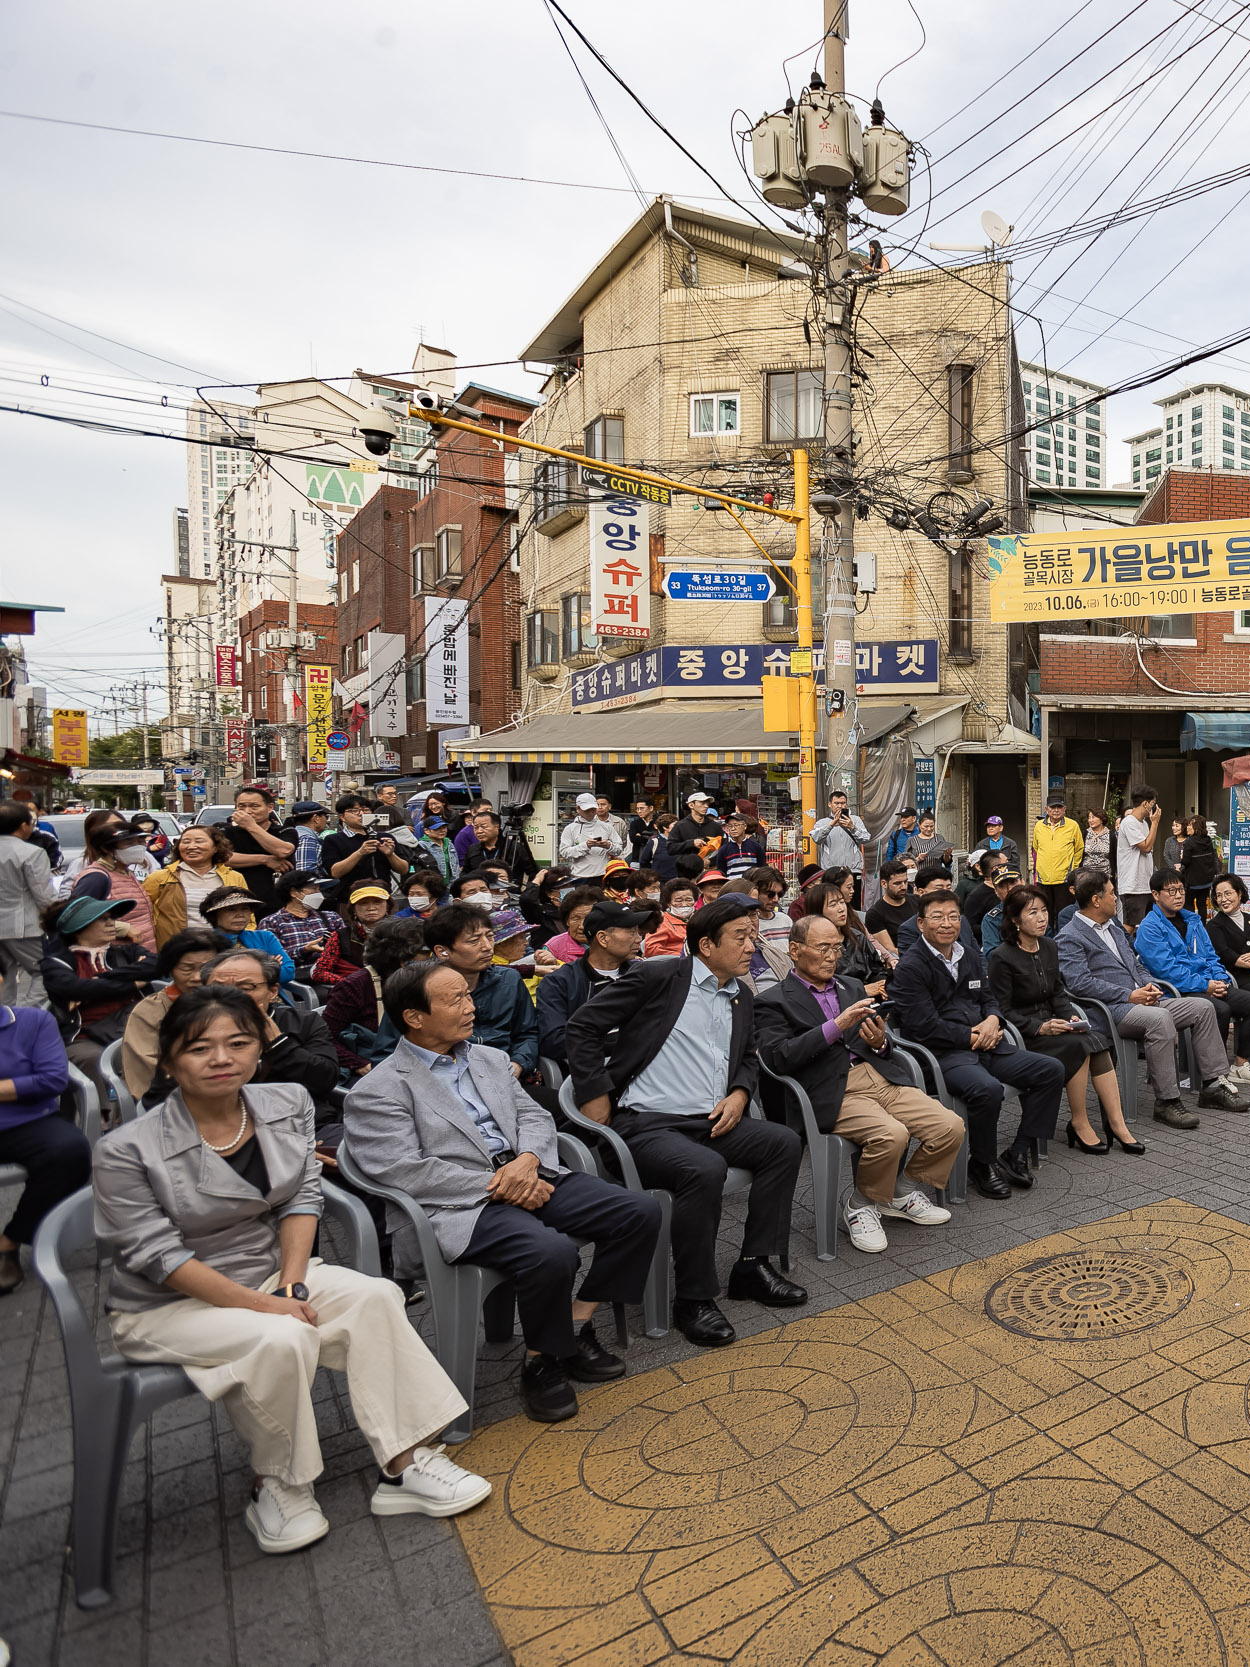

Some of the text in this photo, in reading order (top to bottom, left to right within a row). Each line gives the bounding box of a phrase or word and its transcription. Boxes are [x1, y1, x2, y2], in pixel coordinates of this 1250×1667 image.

[610, 477, 669, 505] CCTV 작동중
[1023, 549, 1073, 570] 능동로
[1078, 540, 1213, 583] 가을낭만
[671, 582, 681, 590] 33
[687, 584, 752, 593] Ttukseom-ro 30-gil
[692, 574, 746, 585] 뚝섬로30길
[757, 583, 767, 591] 37
[1023, 570, 1074, 587] 골목시장
[1103, 589, 1188, 608] 16:00~19:00
[598, 625, 649, 637] 463-2384
[677, 644, 926, 680] 중앙슈마켓
[443, 664, 458, 689] 빠진
[575, 653, 657, 700] 중앙슈퍼마켓
[58, 719, 83, 761] 부동산
[643, 764, 663, 788] 쌀
